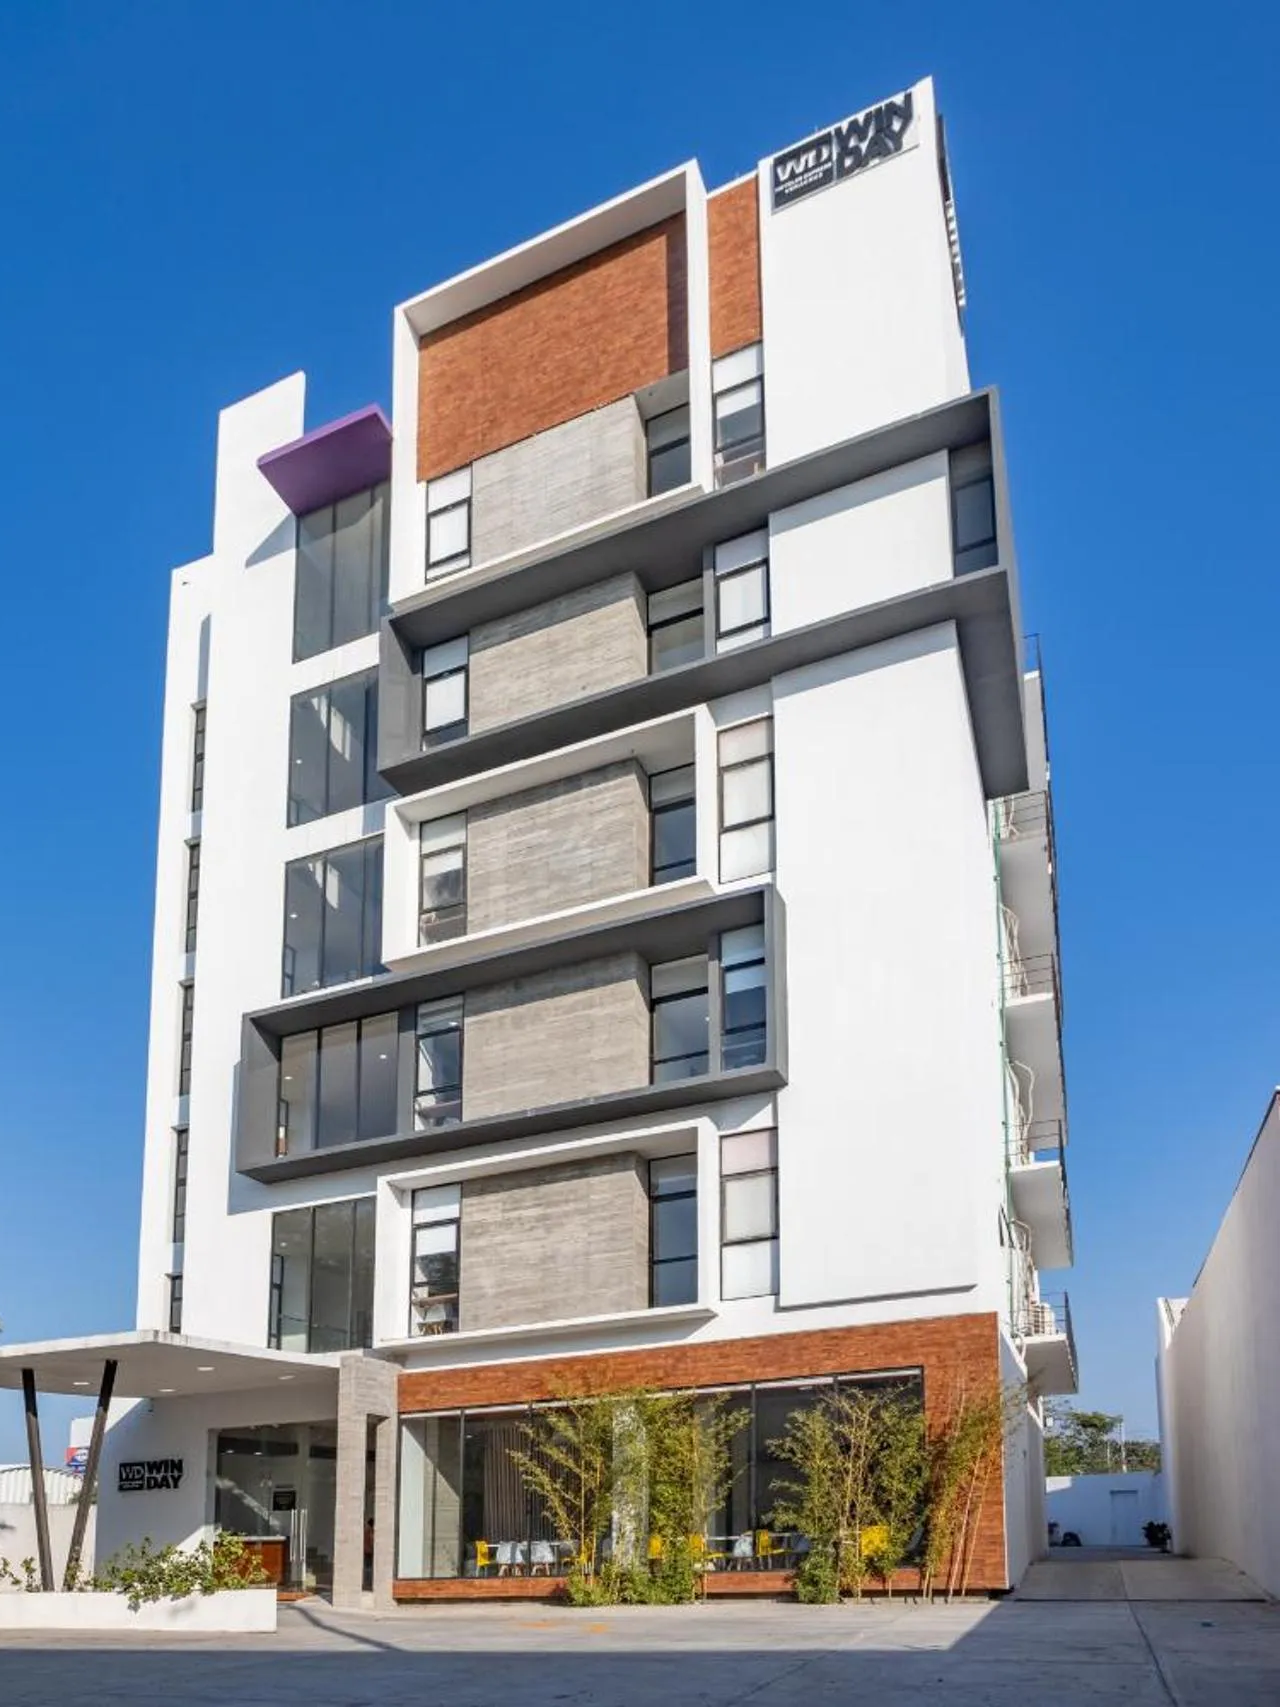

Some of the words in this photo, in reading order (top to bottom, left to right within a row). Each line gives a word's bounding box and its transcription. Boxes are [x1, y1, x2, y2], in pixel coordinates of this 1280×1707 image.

[832, 92, 912, 148] WIN
[836, 119, 911, 179] DAY
[776, 144, 830, 182] WD
[120, 1466, 145, 1480] WD
[146, 1459, 183, 1475] WIN
[146, 1474, 182, 1489] DAY
